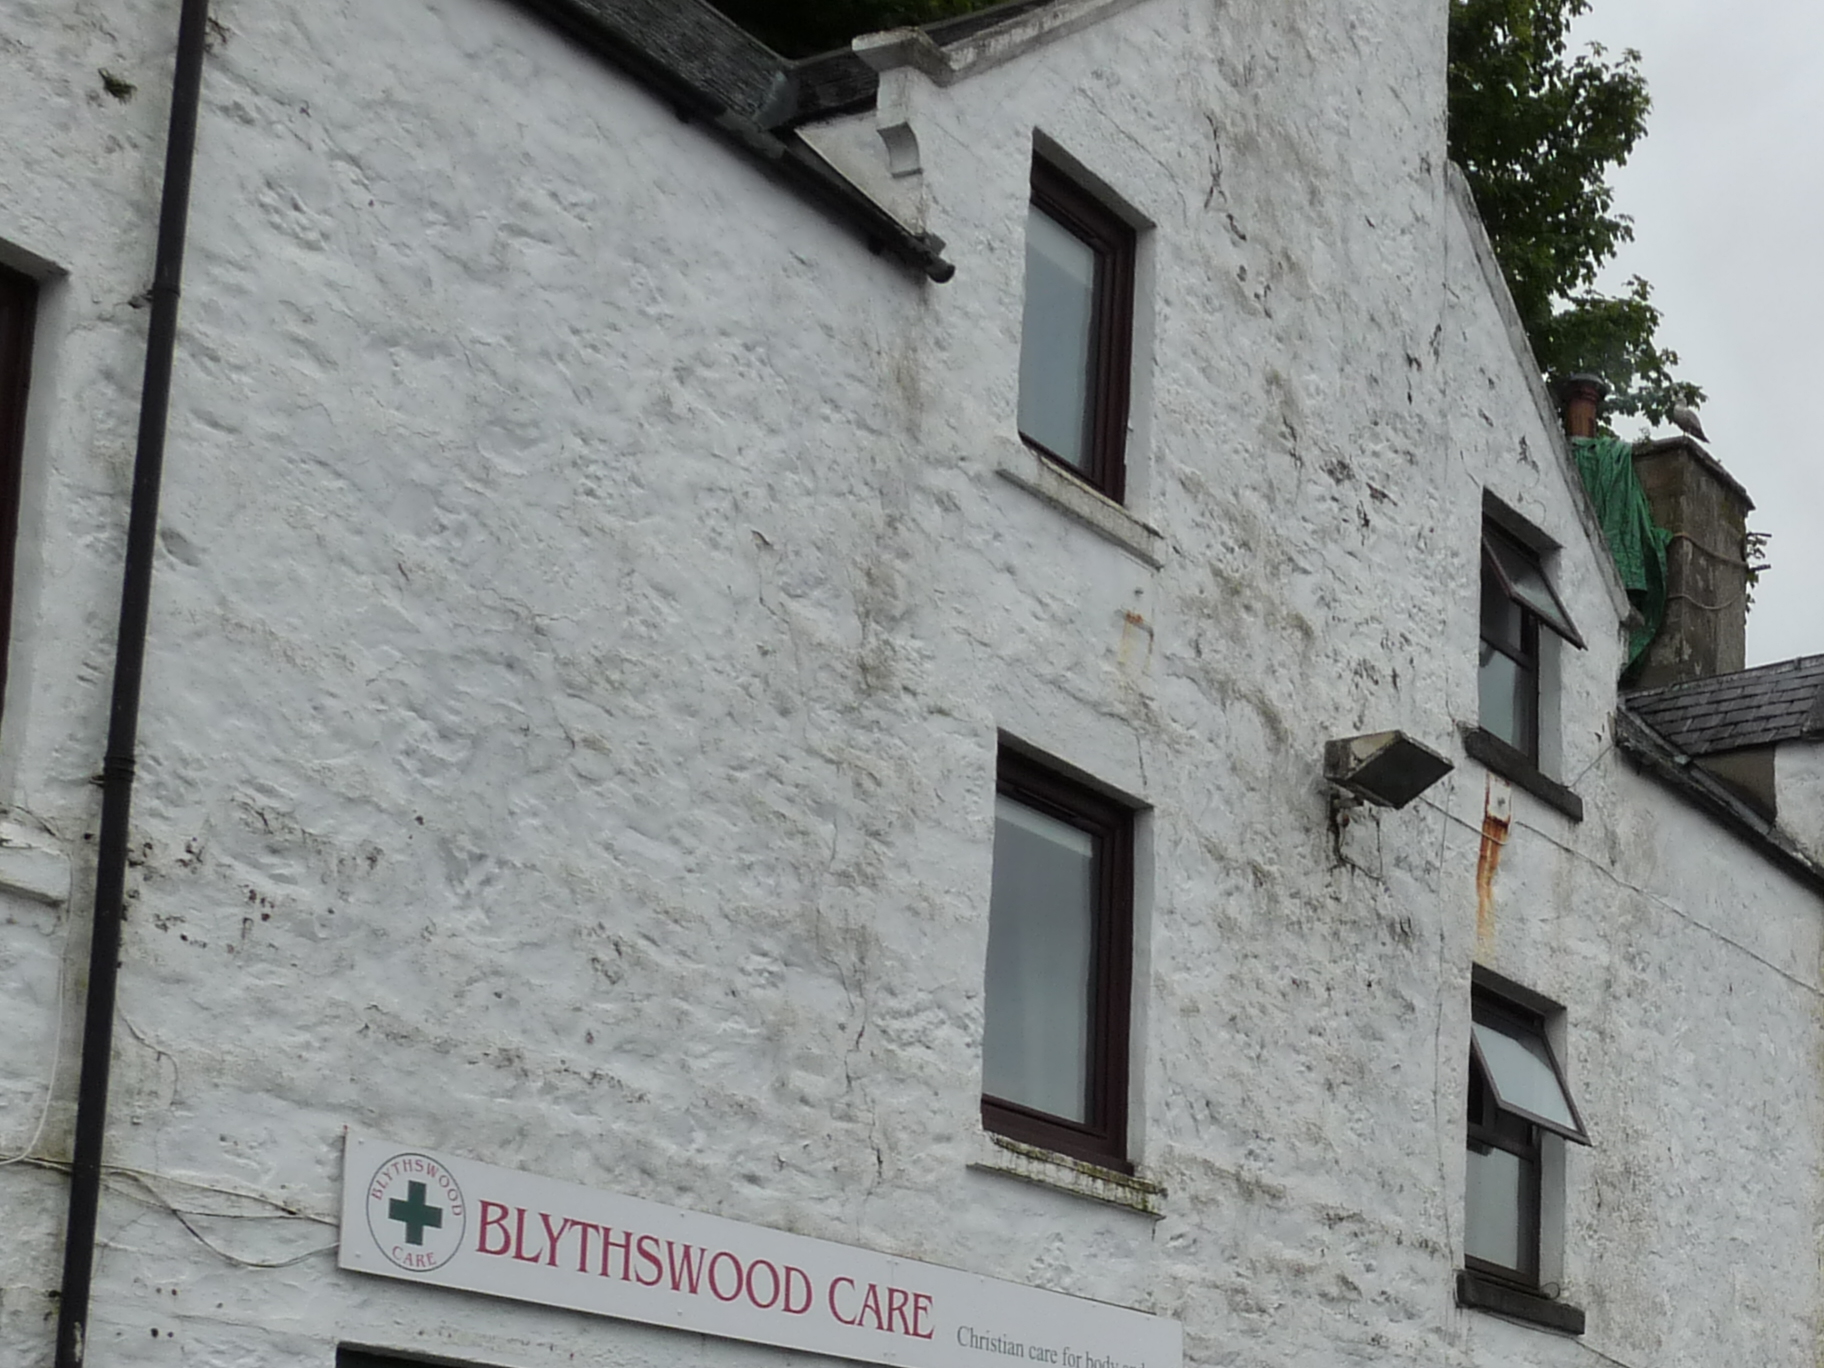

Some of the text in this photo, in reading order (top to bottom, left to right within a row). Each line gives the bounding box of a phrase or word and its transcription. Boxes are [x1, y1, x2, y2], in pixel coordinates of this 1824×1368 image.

[371, 1159, 463, 1217] BLYTHSWOOD
[391, 1245, 437, 1268] CARE
[475, 1199, 935, 1340] BLYTHSWOOD CARE
[957, 1325, 1024, 1358] Christian
[1029, 1344, 1058, 1365] care
[1062, 1346, 1083, 1368] for
